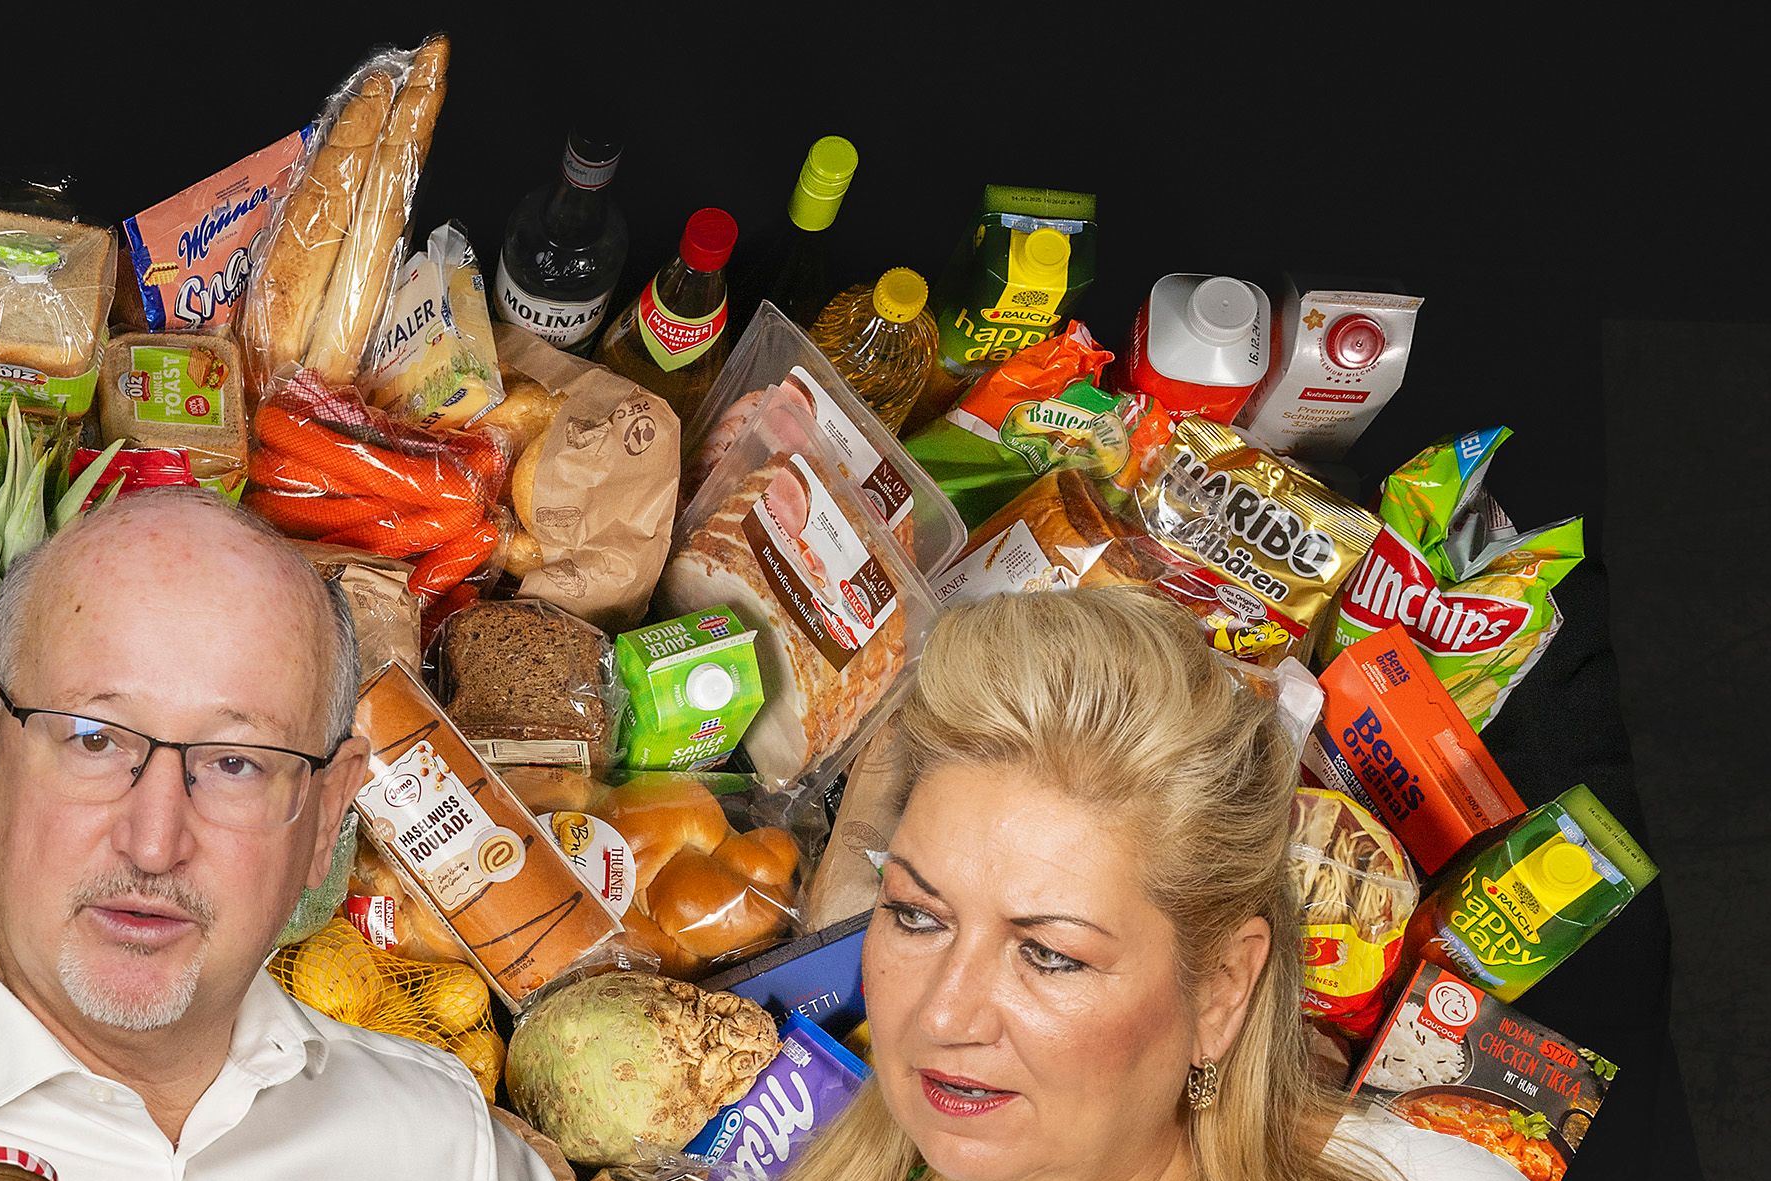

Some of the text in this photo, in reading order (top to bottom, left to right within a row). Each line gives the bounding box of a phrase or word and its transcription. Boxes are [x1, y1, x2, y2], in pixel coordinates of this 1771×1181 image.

[178, 184, 269, 268] Manner
[216, 230, 238, 245] VIENNA
[651, 314, 714, 340] MAUTNER
[1000, 310, 1053, 326] RAUCH
[655, 330, 701, 345] MARKHOF
[154, 370, 163, 404] DINKEL
[164, 356, 181, 416] TOAST
[1303, 390, 1365, 403] SalzburgMilch
[617, 401, 651, 420] PEFC
[1282, 412, 1356, 424] Schlagobers
[1290, 421, 1317, 430] 32%
[1297, 406, 1350, 419] Premium
[1161, 449, 1335, 578] HARIBO
[762, 546, 824, 640] Backofen-Schinken
[843, 583, 873, 629] BERGER
[1221, 585, 1261, 612] Das Original
[1238, 601, 1255, 615] 1922
[639, 623, 687, 644] MILCH
[646, 633, 697, 659] SAUER
[1375, 655, 1401, 687] Original
[1383, 649, 1411, 684] Ben's
[668, 745, 720, 768] MILCH
[672, 735, 727, 759] SAUER
[1352, 706, 1425, 812] Ben's
[390, 778, 413, 802] Jomo
[1323, 767, 1333, 783] RIZ
[1343, 727, 1411, 823] Original
[1465, 794, 1478, 812] 500
[398, 795, 461, 847] HASELNUSS
[409, 808, 473, 864] ROULADE
[609, 846, 625, 902] THURNER
[386, 899, 396, 946] KONSUMENT
[1461, 867, 1546, 966] happy
[1497, 893, 1534, 937] RAUCH
[1451, 910, 1507, 966] day
[1498, 1017, 1576, 1068] INDIAN STYLE
[1478, 1032, 1582, 1100] CHICKEN TIKKA
[1503, 1070, 1539, 1098] MIT HUHN
[705, 1109, 743, 1165] OREO
